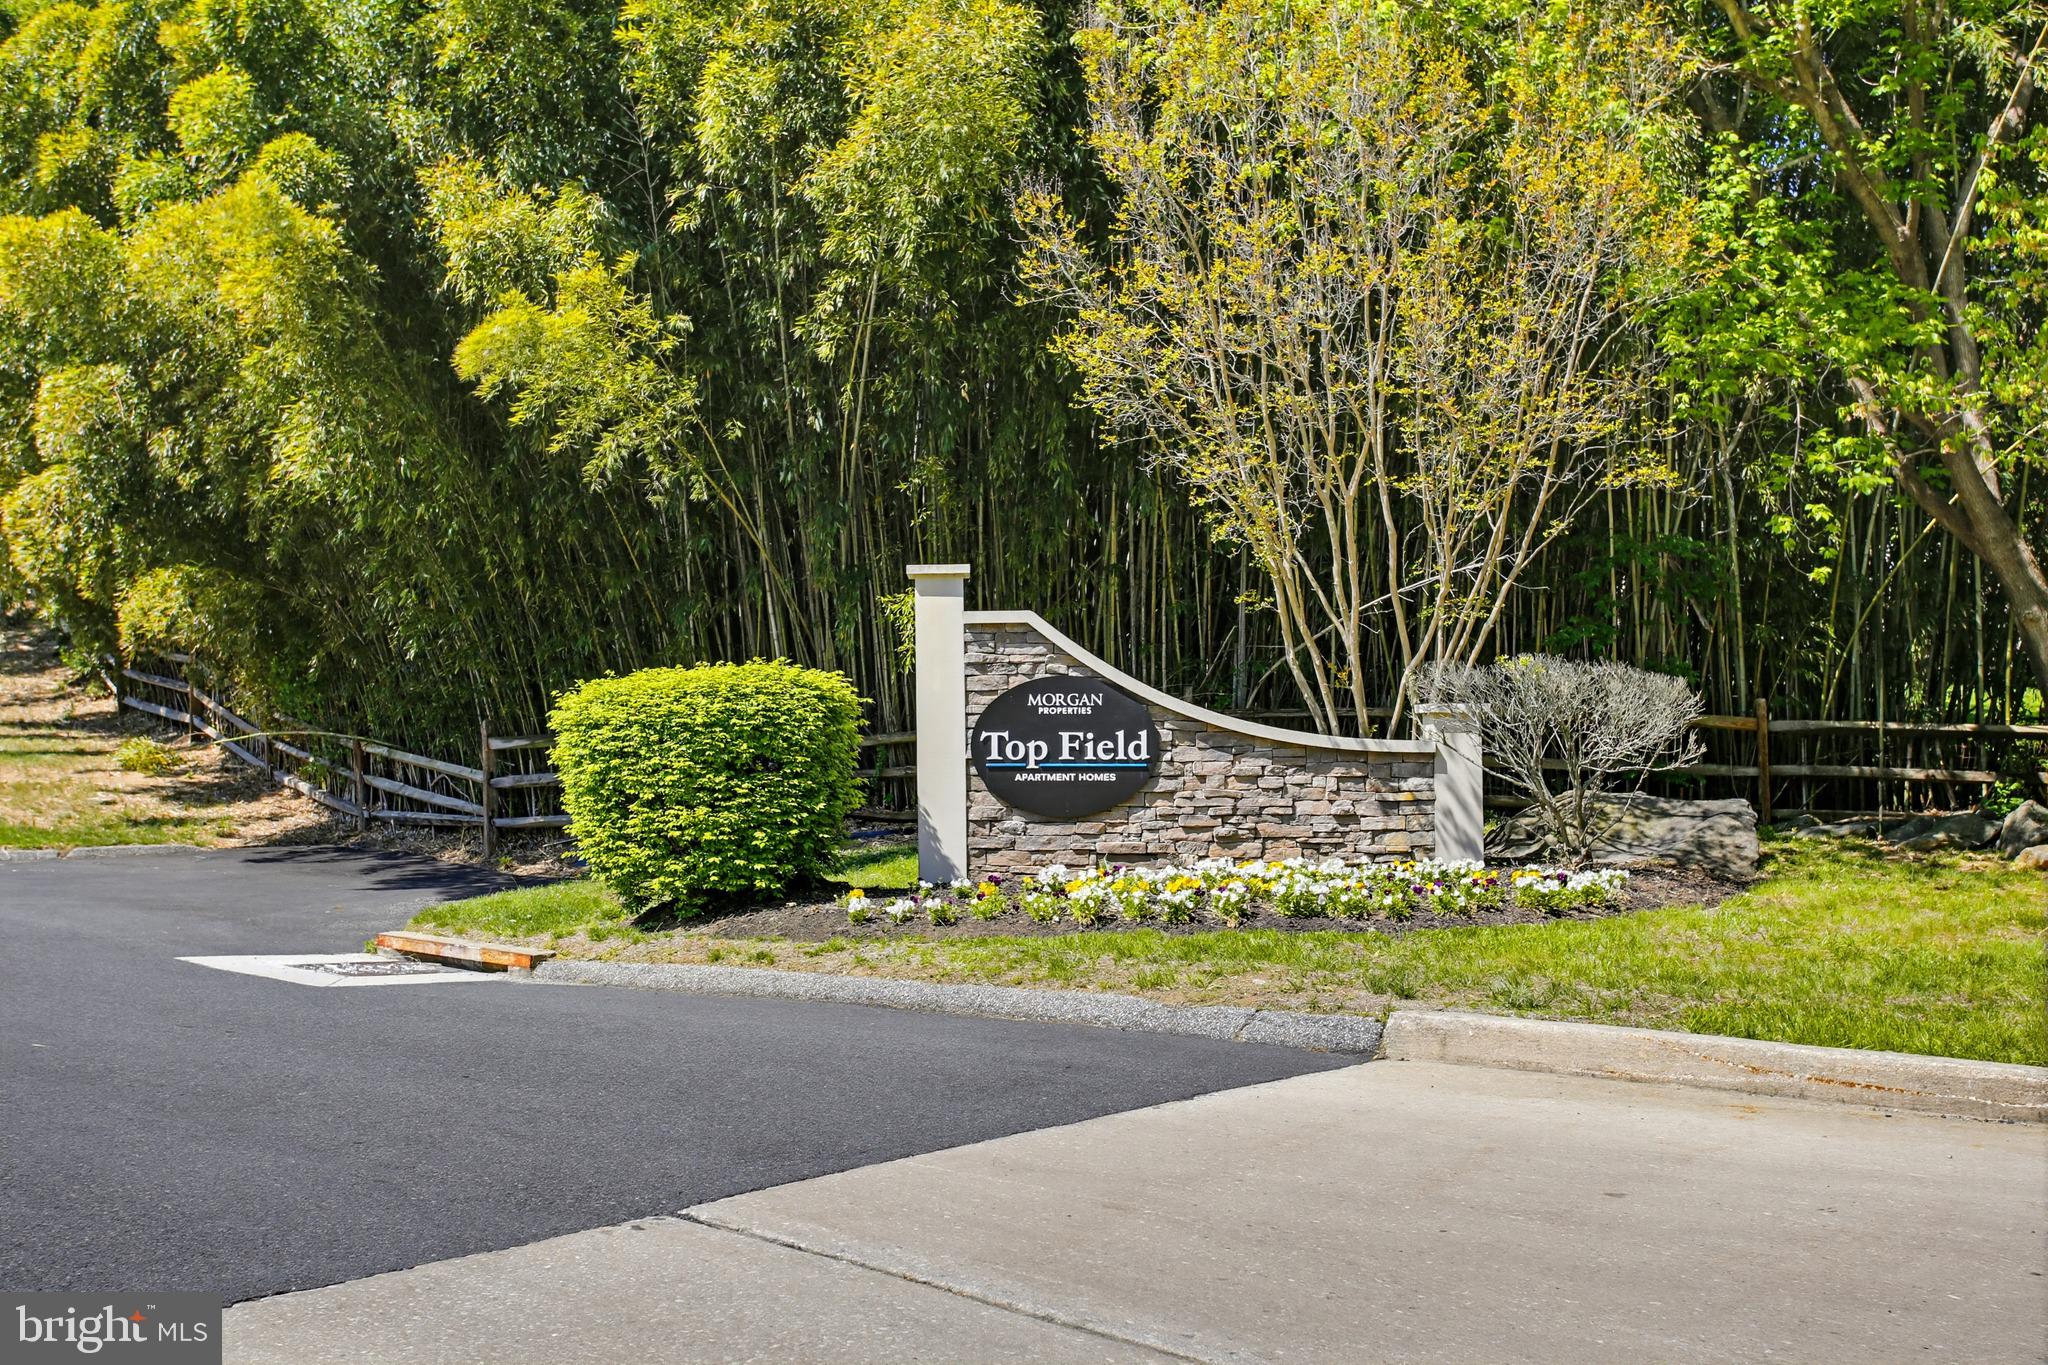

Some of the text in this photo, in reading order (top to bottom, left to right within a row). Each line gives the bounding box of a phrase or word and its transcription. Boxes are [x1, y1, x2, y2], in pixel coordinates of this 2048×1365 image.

[1027, 693, 1104, 706] MORGAN
[1038, 706, 1092, 715] PROPERTIES
[980, 729, 1151, 769] Top Field
[1014, 773, 1116, 782] APARTMENT HOMES
